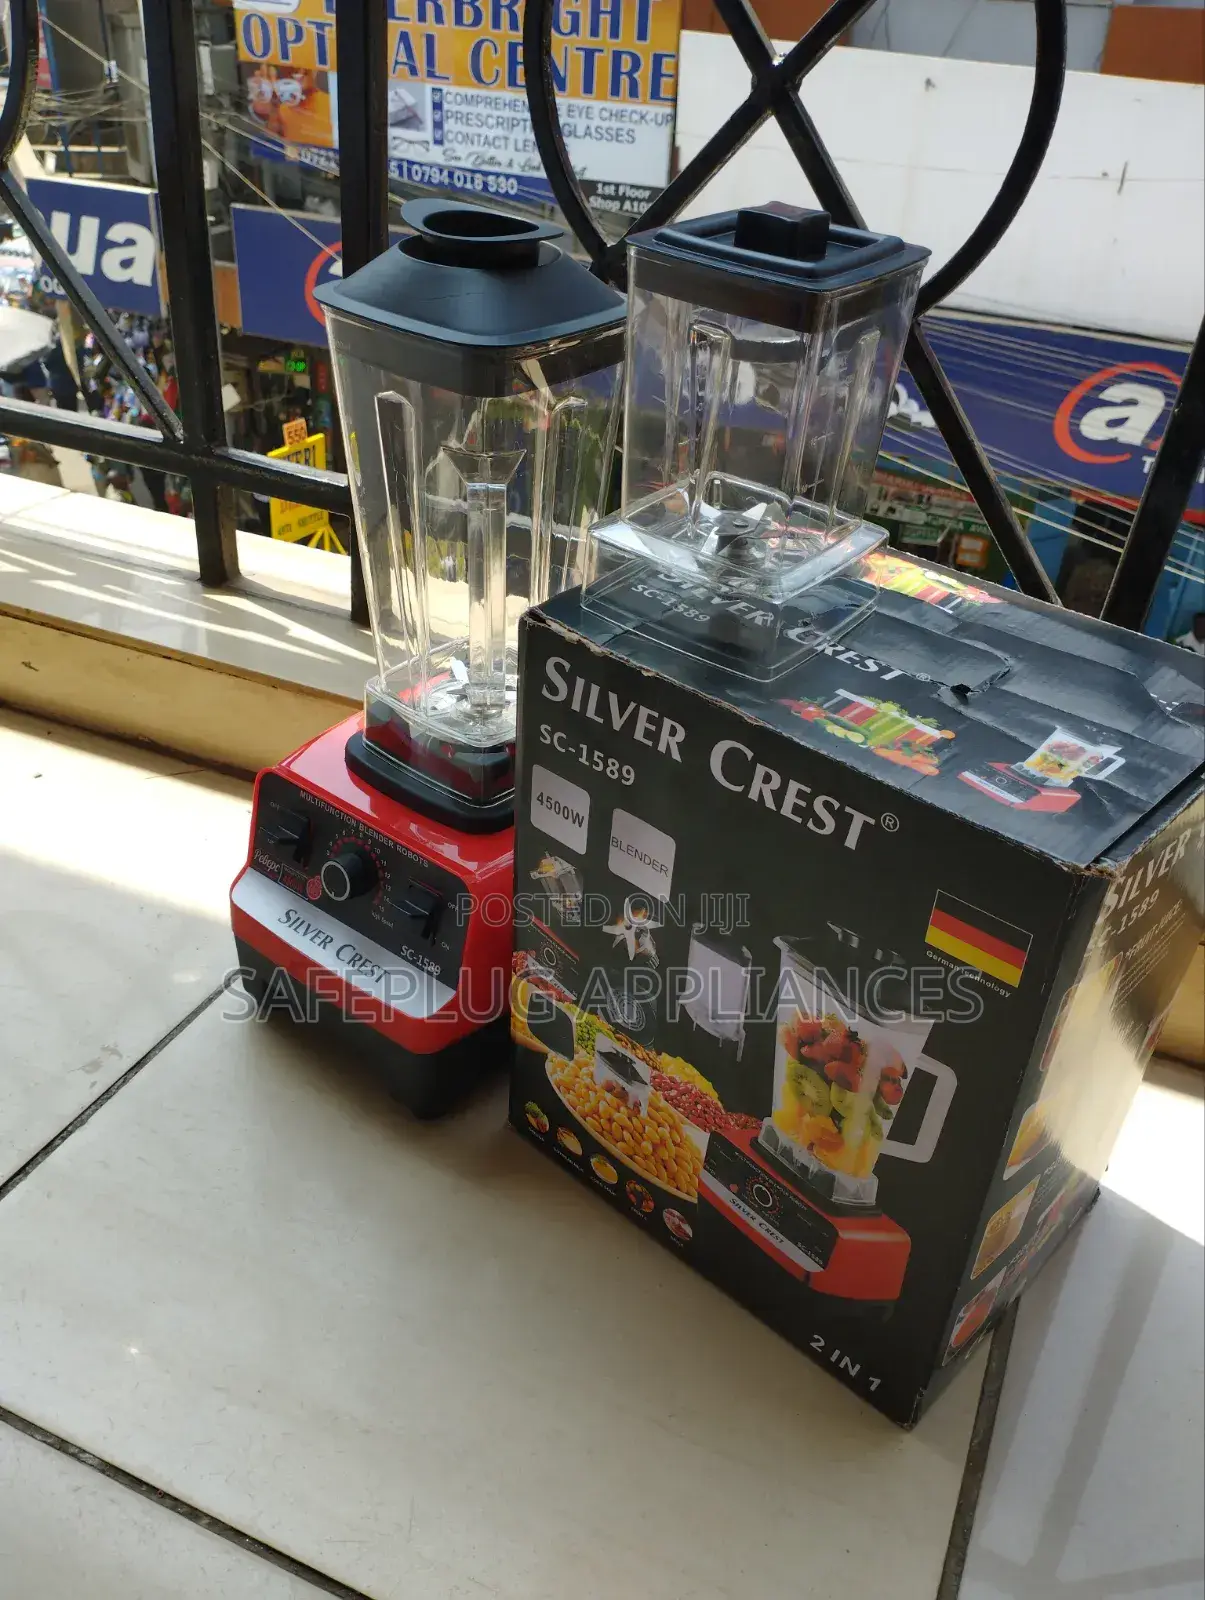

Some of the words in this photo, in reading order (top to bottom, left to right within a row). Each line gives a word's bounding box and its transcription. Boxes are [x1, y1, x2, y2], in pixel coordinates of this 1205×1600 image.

[242, 13, 450, 81] OPTAL
[470, 38, 677, 101] CENTRE
[444, 91, 561, 119] COMPREHEN
[567, 103, 595, 120] EYE
[598, 107, 674, 127] CHECK-UP
[445, 129, 510, 151] CONTACT
[560, 122, 637, 144] GLASSES
[411, 164, 450, 186] 0794
[596, 182, 616, 196] 1st
[618, 184, 652, 200] Floor
[541, 656, 687, 763] SILVER
[539, 723, 636, 787] SC-1589
[536, 791, 586, 829] 4500W
[300, 790, 357, 828] MULTIFUNCTION
[359, 822, 395, 849] BLENDER
[396, 842, 429, 869] ROBOTS
[610, 835, 670, 879] BLENDER
[278, 908, 335, 951] SILVER
[335, 943, 391, 985] CREST
[400, 944, 442, 977] SC-1589
[925, 949, 960, 972] German
[758, 1221, 785, 1244] CREST
[809, 1334, 826, 1353] 2
[830, 1348, 861, 1378] IN
[868, 1376, 882, 1392] 1
